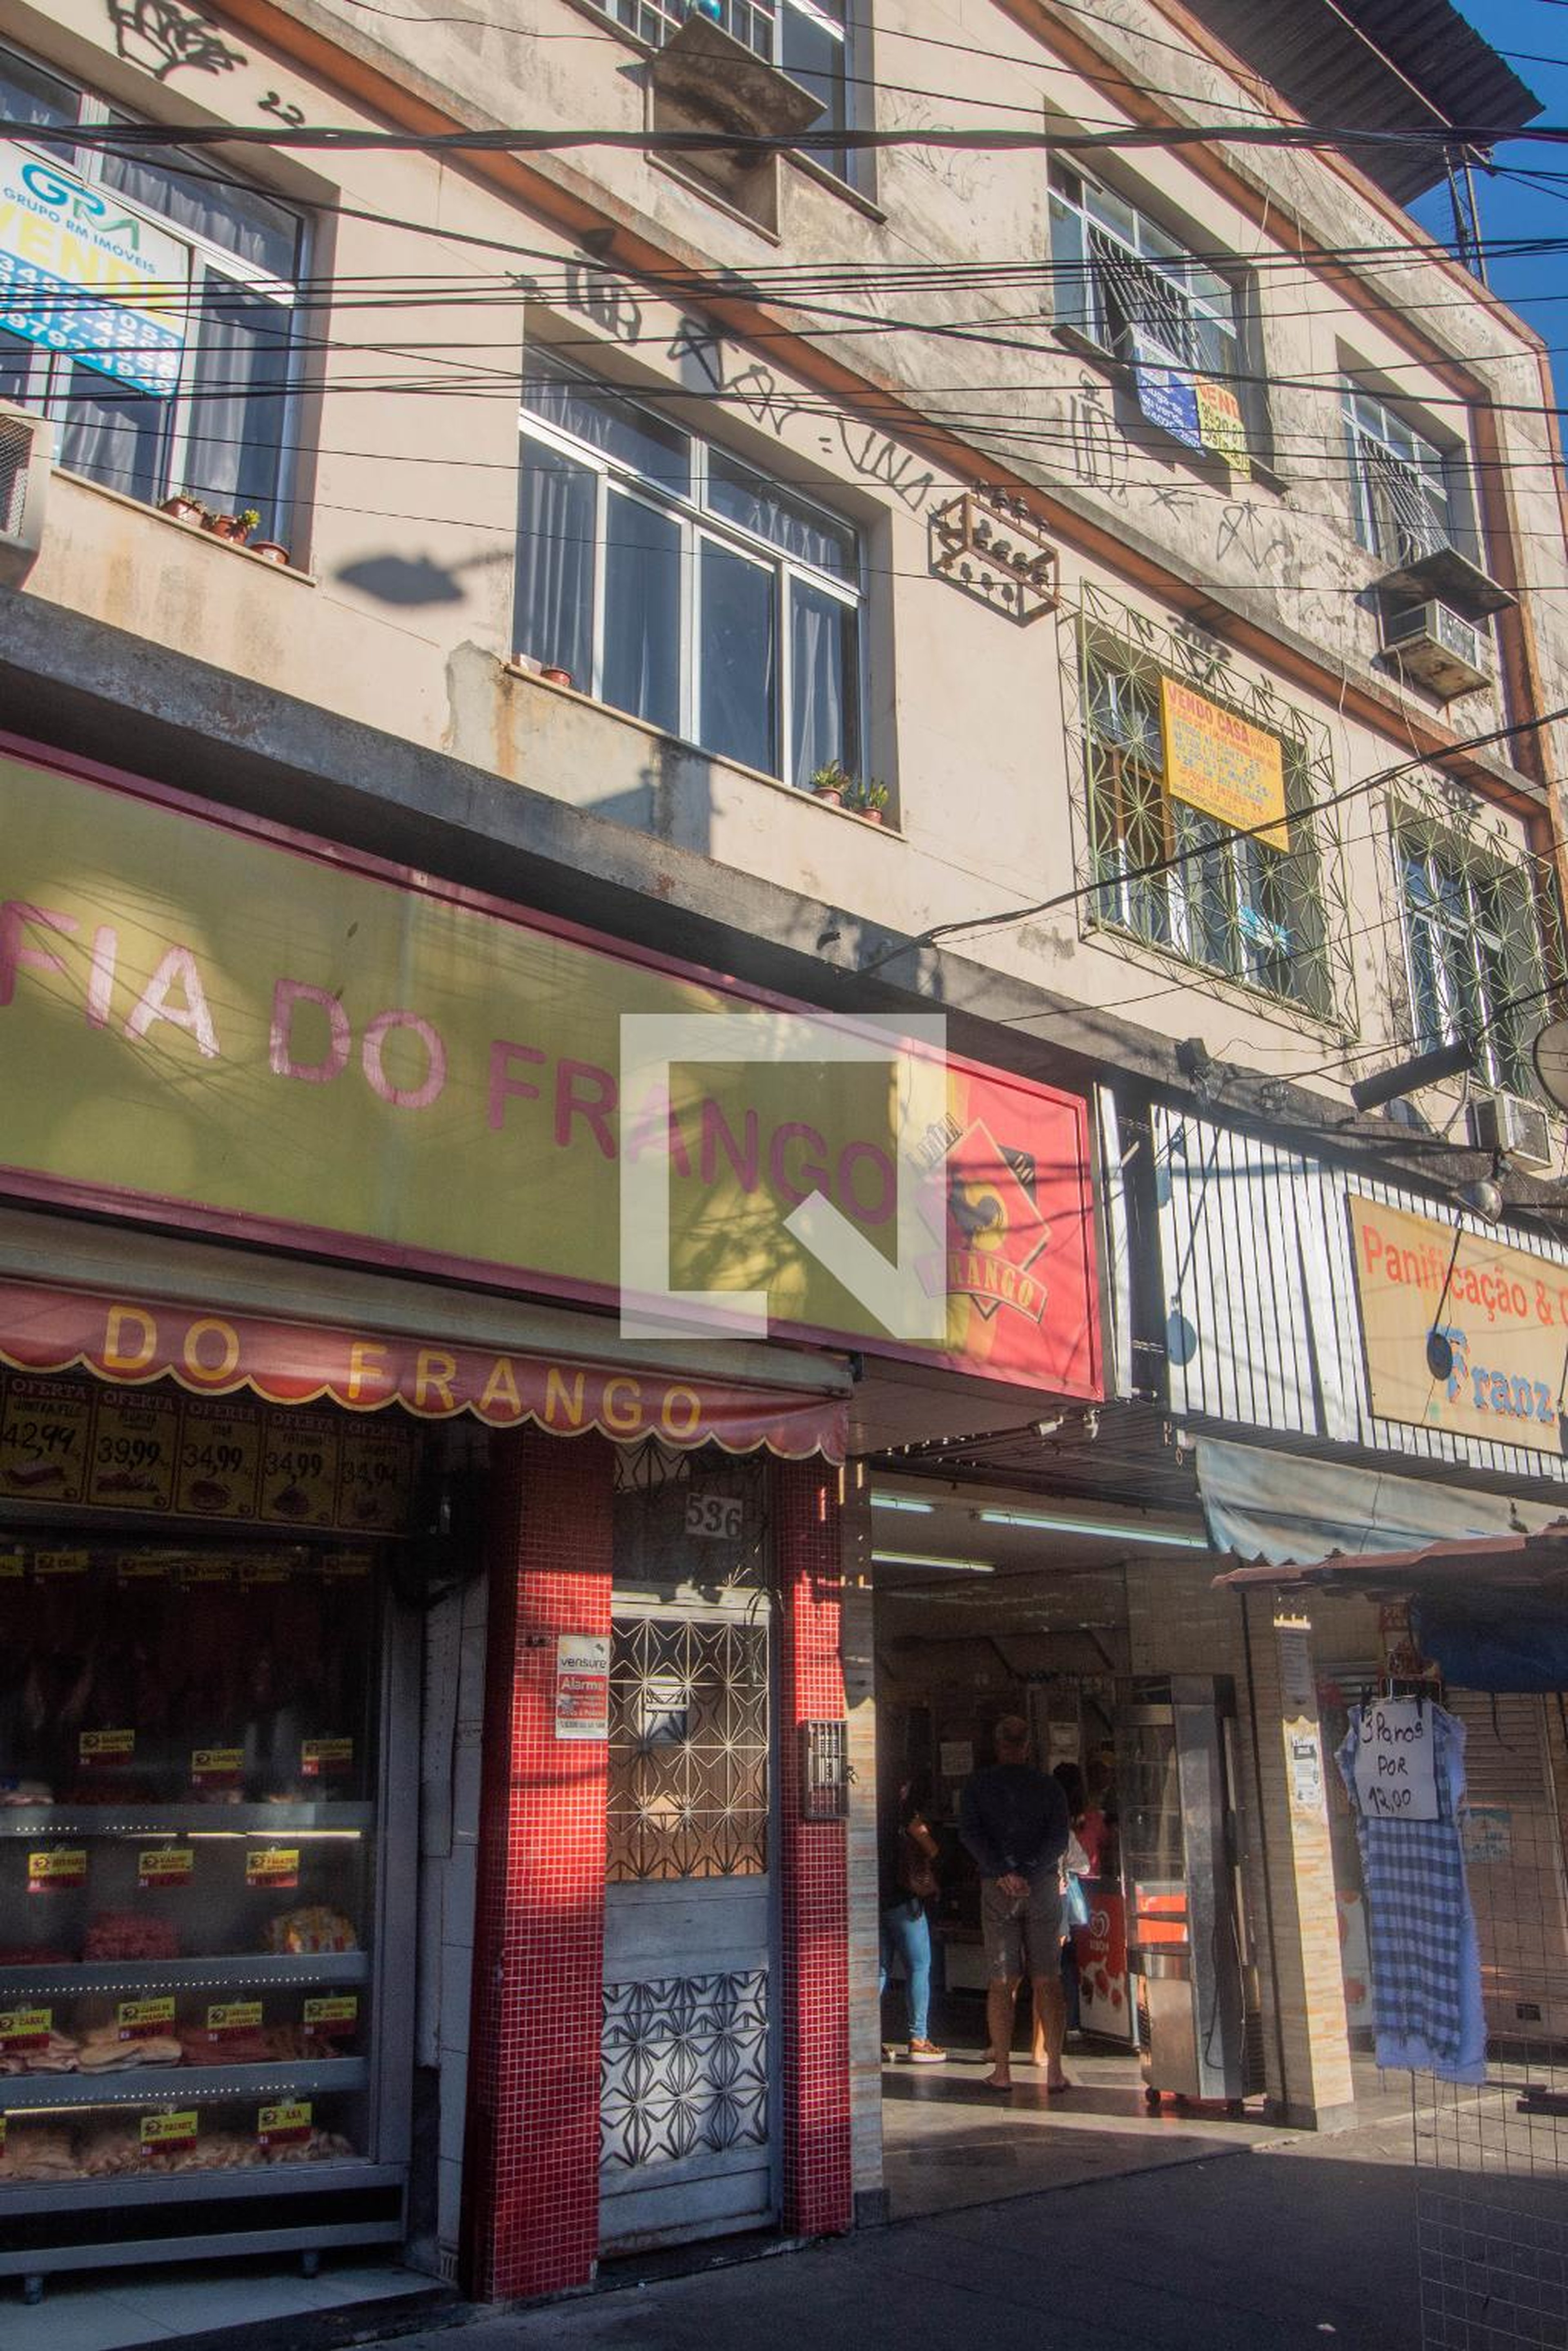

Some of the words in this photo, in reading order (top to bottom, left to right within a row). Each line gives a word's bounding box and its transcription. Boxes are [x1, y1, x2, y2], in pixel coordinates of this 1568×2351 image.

[3, 187, 61, 223] GRUPO
[66, 219, 89, 239] RM
[1168, 684, 1213, 725] VENDO
[1217, 710, 1250, 747] CASA
[270, 978, 448, 1109] DO
[488, 1039, 898, 1225] FRANGO
[1362, 1225, 1527, 1323] Panificação
[1535, 1279, 1554, 1325] &
[103, 1305, 241, 1382] DO
[347, 1341, 702, 1438] FRANGO
[561, 1676, 606, 1691] Alarme
[1376, 1711, 1423, 1744] Panos
[1377, 1755, 1409, 1777] POR
